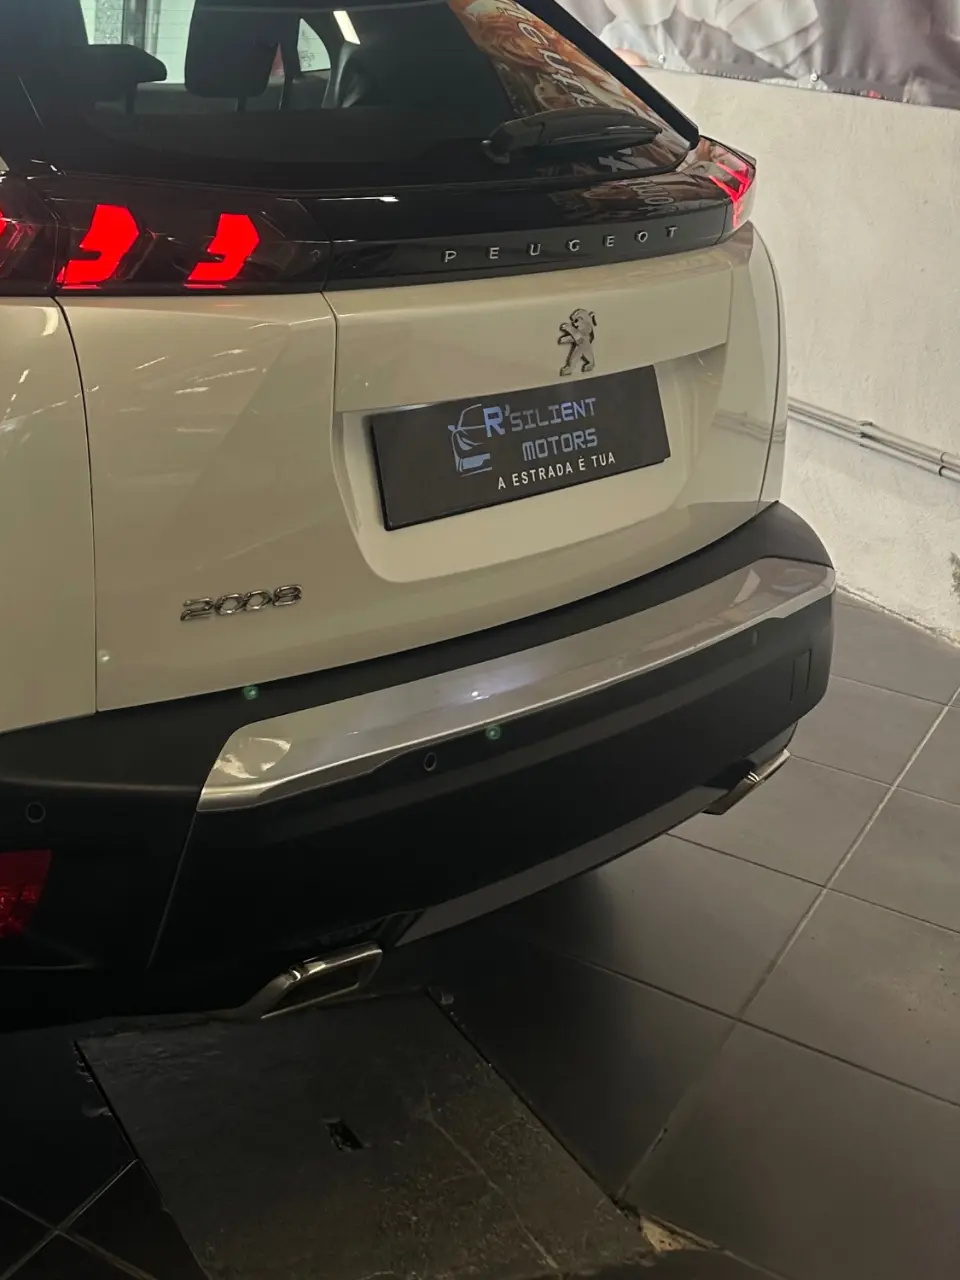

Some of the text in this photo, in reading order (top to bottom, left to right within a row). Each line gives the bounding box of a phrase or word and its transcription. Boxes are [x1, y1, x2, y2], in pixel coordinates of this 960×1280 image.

[444, 225, 678, 263] PEUGEOT
[522, 428, 599, 461] MOTORS
[498, 451, 616, 490] A ESTRADA É TUA
[180, 583, 302, 621] 2008
